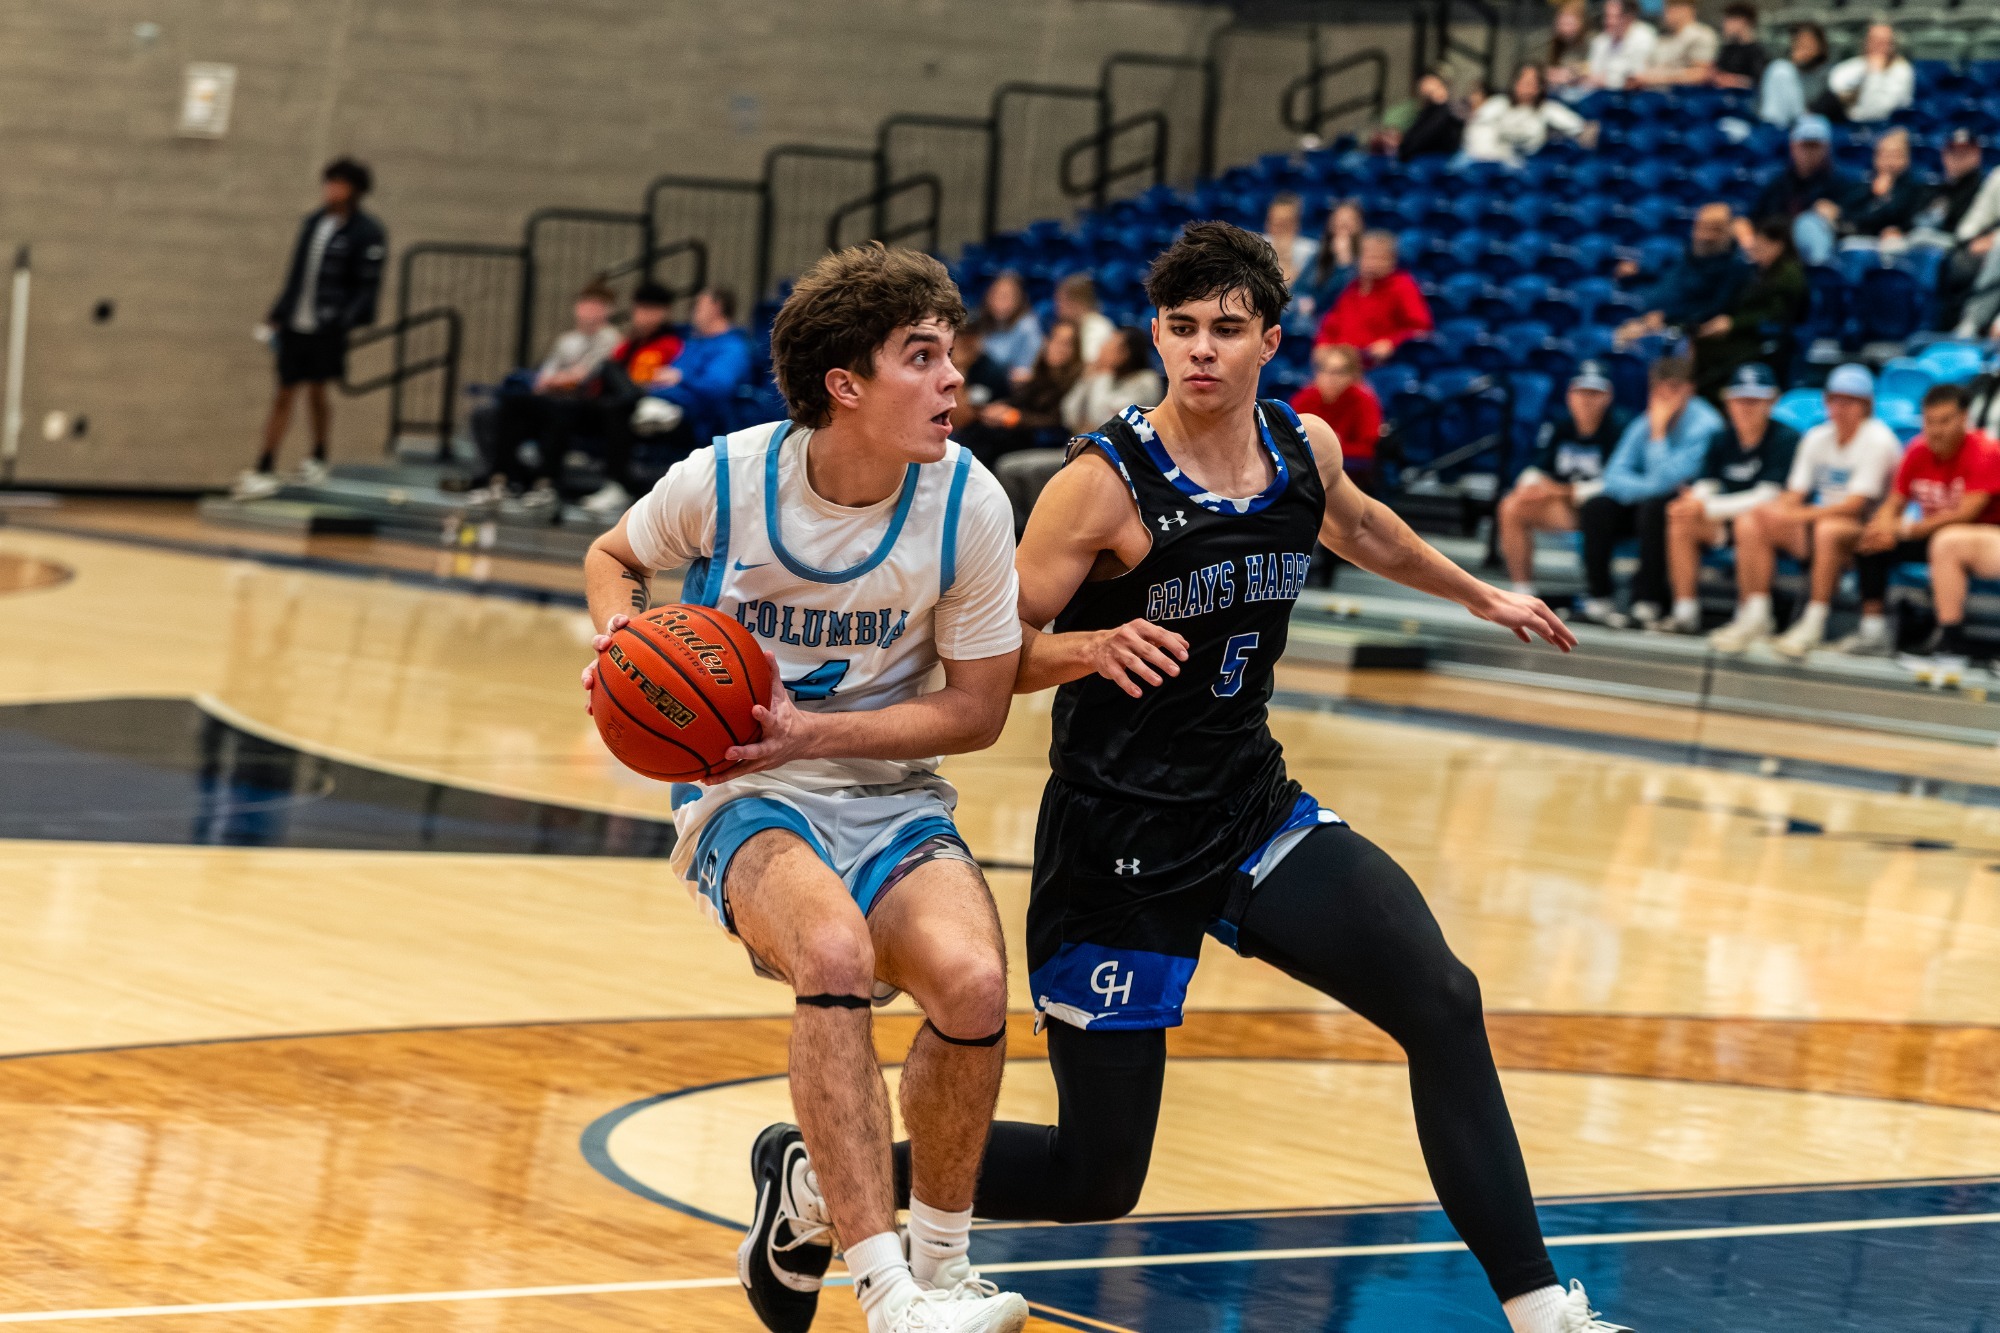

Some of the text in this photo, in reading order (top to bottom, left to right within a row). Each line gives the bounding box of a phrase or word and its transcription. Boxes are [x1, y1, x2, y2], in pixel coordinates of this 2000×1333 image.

[1146, 553, 1311, 622] GRAYS HARB
[646, 610, 734, 686] Baden
[735, 599, 911, 649] COLUMBIA
[782, 659, 851, 702] 4
[1210, 632, 1260, 698] 5
[1090, 960, 1134, 1008] GH
